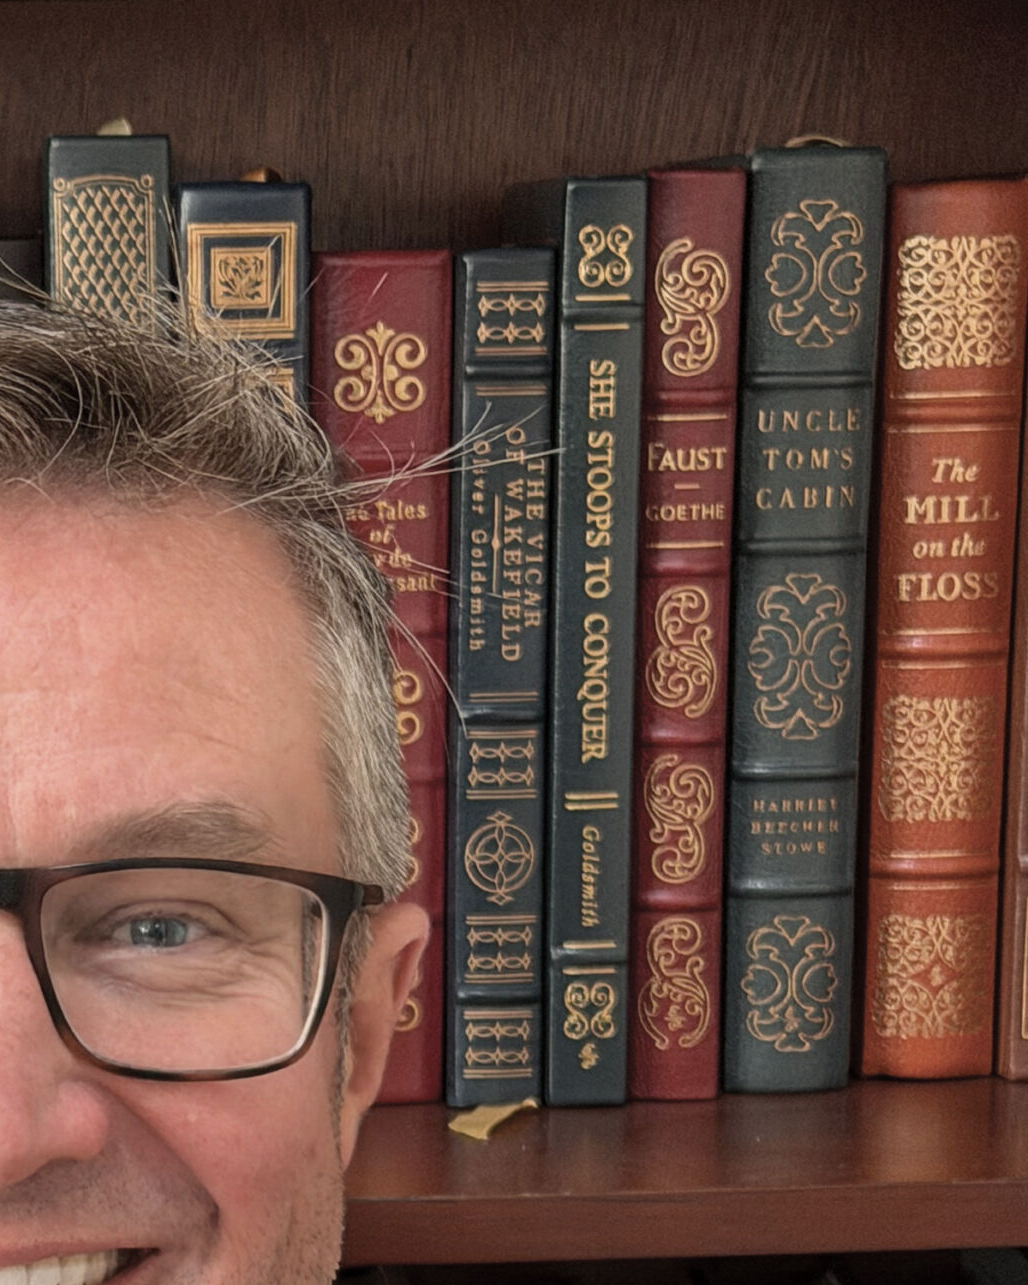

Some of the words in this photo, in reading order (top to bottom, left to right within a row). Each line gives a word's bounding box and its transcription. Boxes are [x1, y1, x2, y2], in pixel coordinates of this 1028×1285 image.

[589, 359, 616, 420] SHE
[757, 408, 860, 433] UNCLE
[505, 427, 525, 465] OF
[648, 442, 727, 471] FAUST
[762, 447, 853, 471] TOM'S
[472, 440, 491, 515] Oliver
[932, 457, 981, 483] The
[526, 459, 546, 520] THE
[585, 430, 614, 547] STOOPS
[756, 485, 854, 510] CABIN
[374, 500, 427, 520] Tales
[646, 503, 726, 521] GOETHE
[903, 495, 1000, 524] MILL
[369, 524, 394, 544] of
[912, 541, 944, 559] on
[951, 531, 986, 558] the
[501, 478, 524, 662] WAKEFIELD
[524, 533, 545, 628] VICAR
[584, 557, 611, 599] TO
[469, 528, 487, 651] Goldsmith
[895, 571, 999, 602] FLOSS
[577, 613, 609, 765] CONQUER
[753, 798, 836, 813] HARRIET
[761, 840, 826, 856] STOWE
[581, 825, 601, 927] Goldsmith
